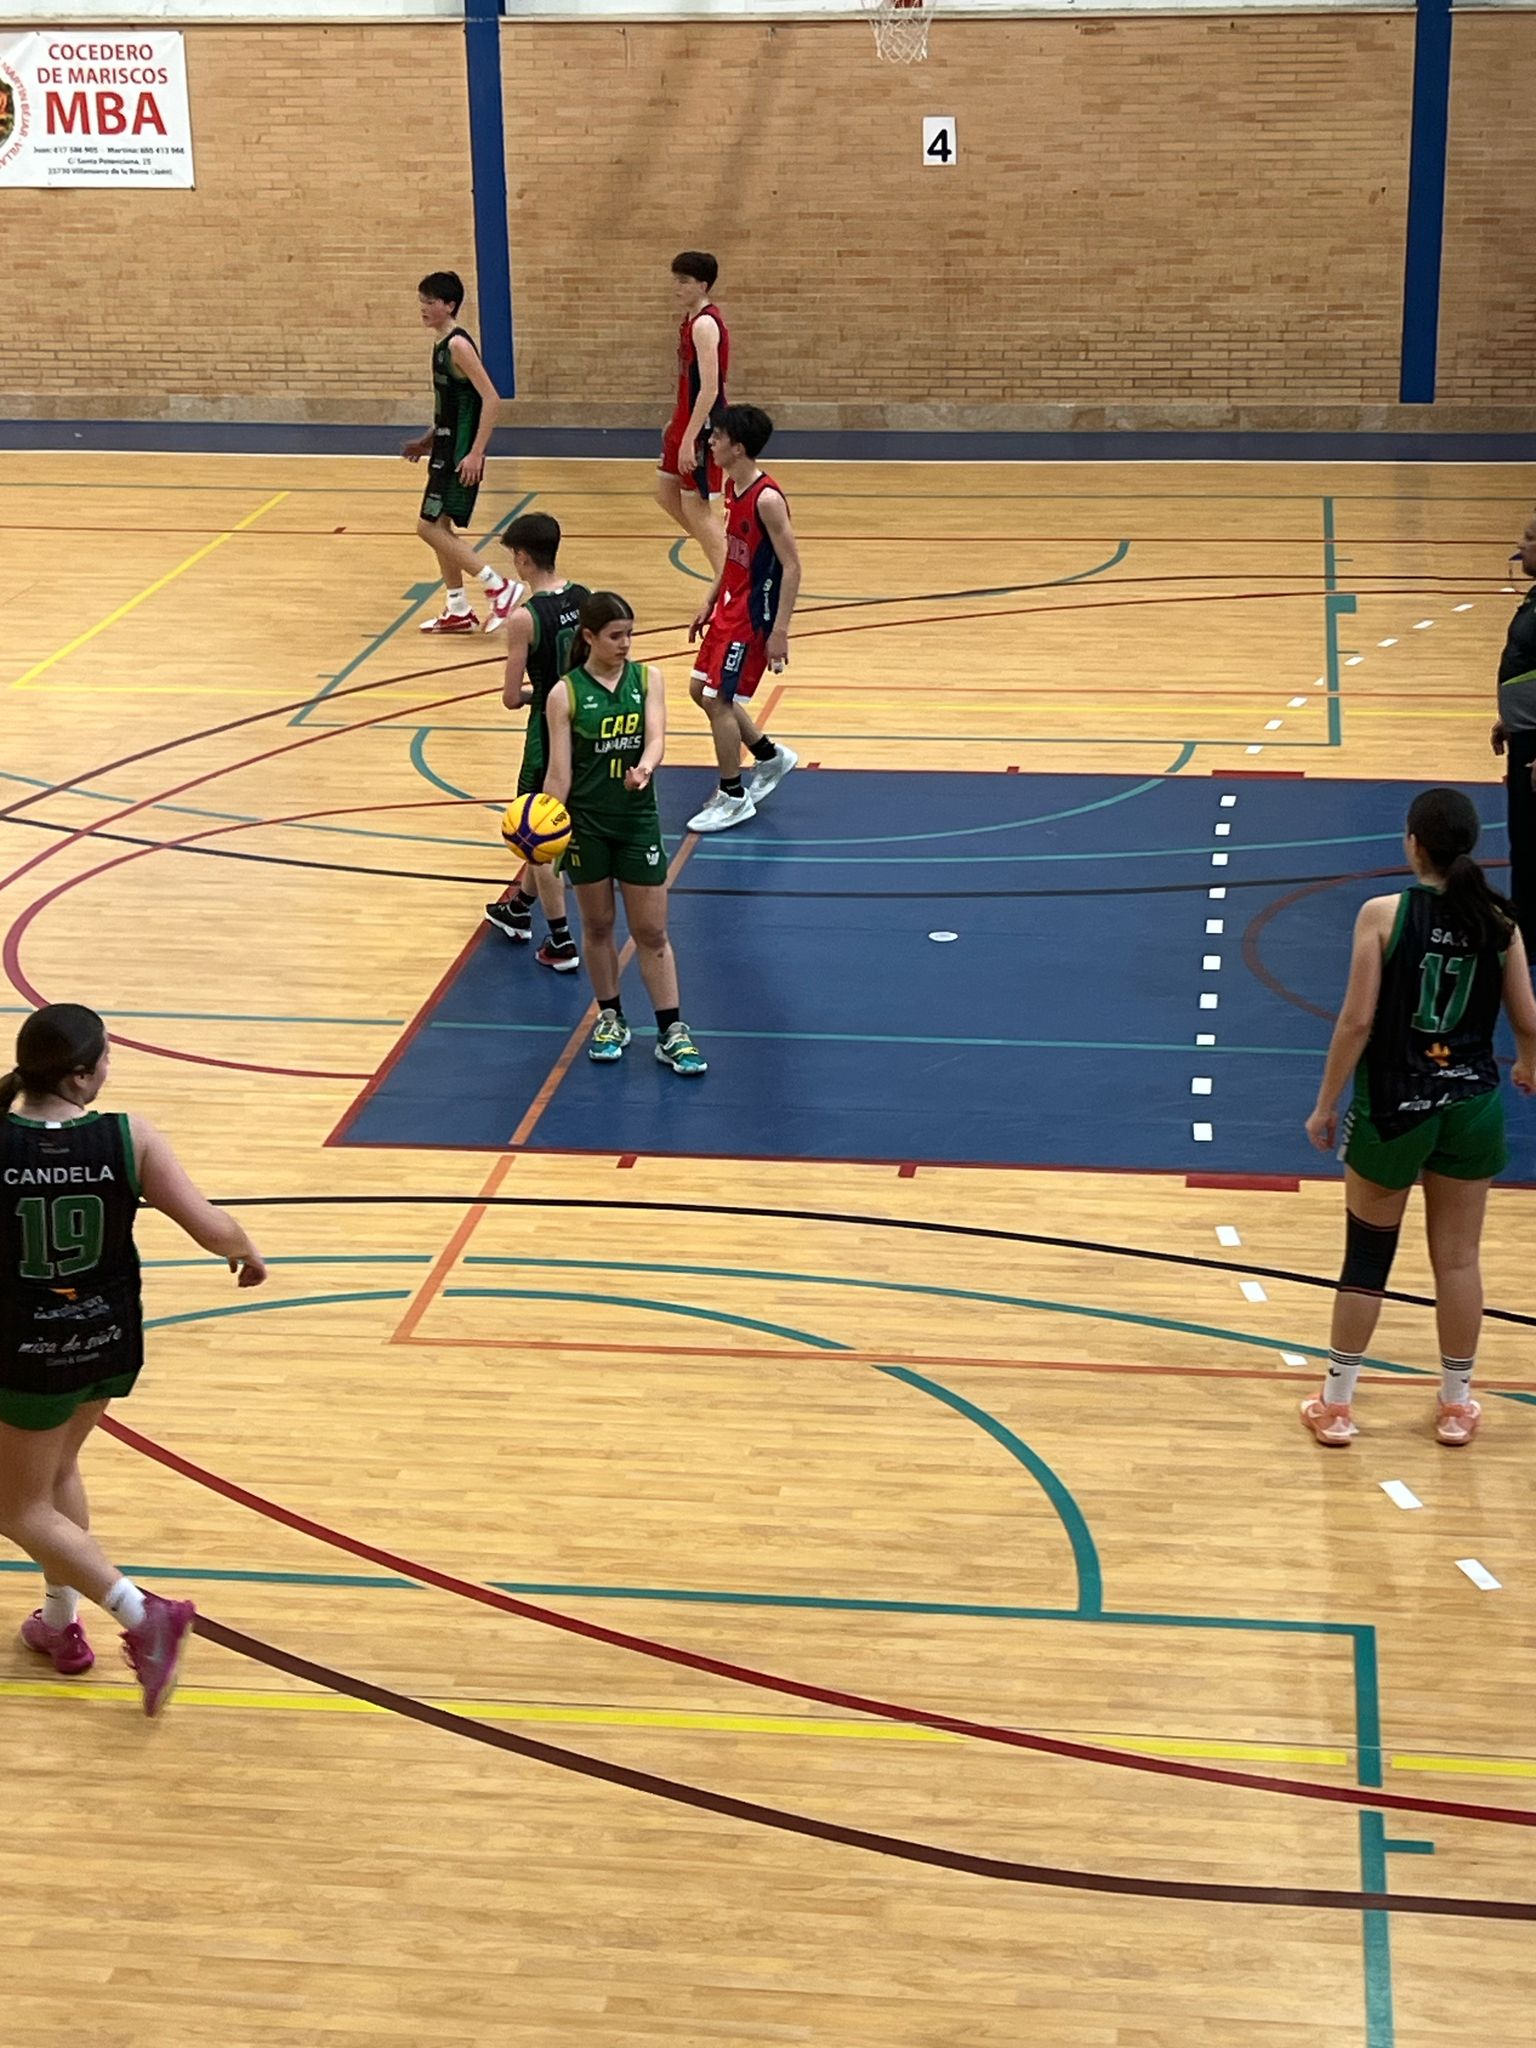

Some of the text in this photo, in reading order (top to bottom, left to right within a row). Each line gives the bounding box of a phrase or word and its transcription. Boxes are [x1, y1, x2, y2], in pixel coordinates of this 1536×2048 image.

[48, 44, 153, 60] COCEDERO
[37, 67, 169, 84] DE MARISCOS
[45, 91, 168, 136] MBA
[927, 128, 952, 163] 4
[601, 713, 640, 739] CAB
[594, 734, 643, 753] LINARES
[610, 758, 622, 778] 11
[1411, 952, 1478, 1033] 17
[3, 1165, 115, 1185] CANDELA
[15, 1194, 104, 1279] 19
